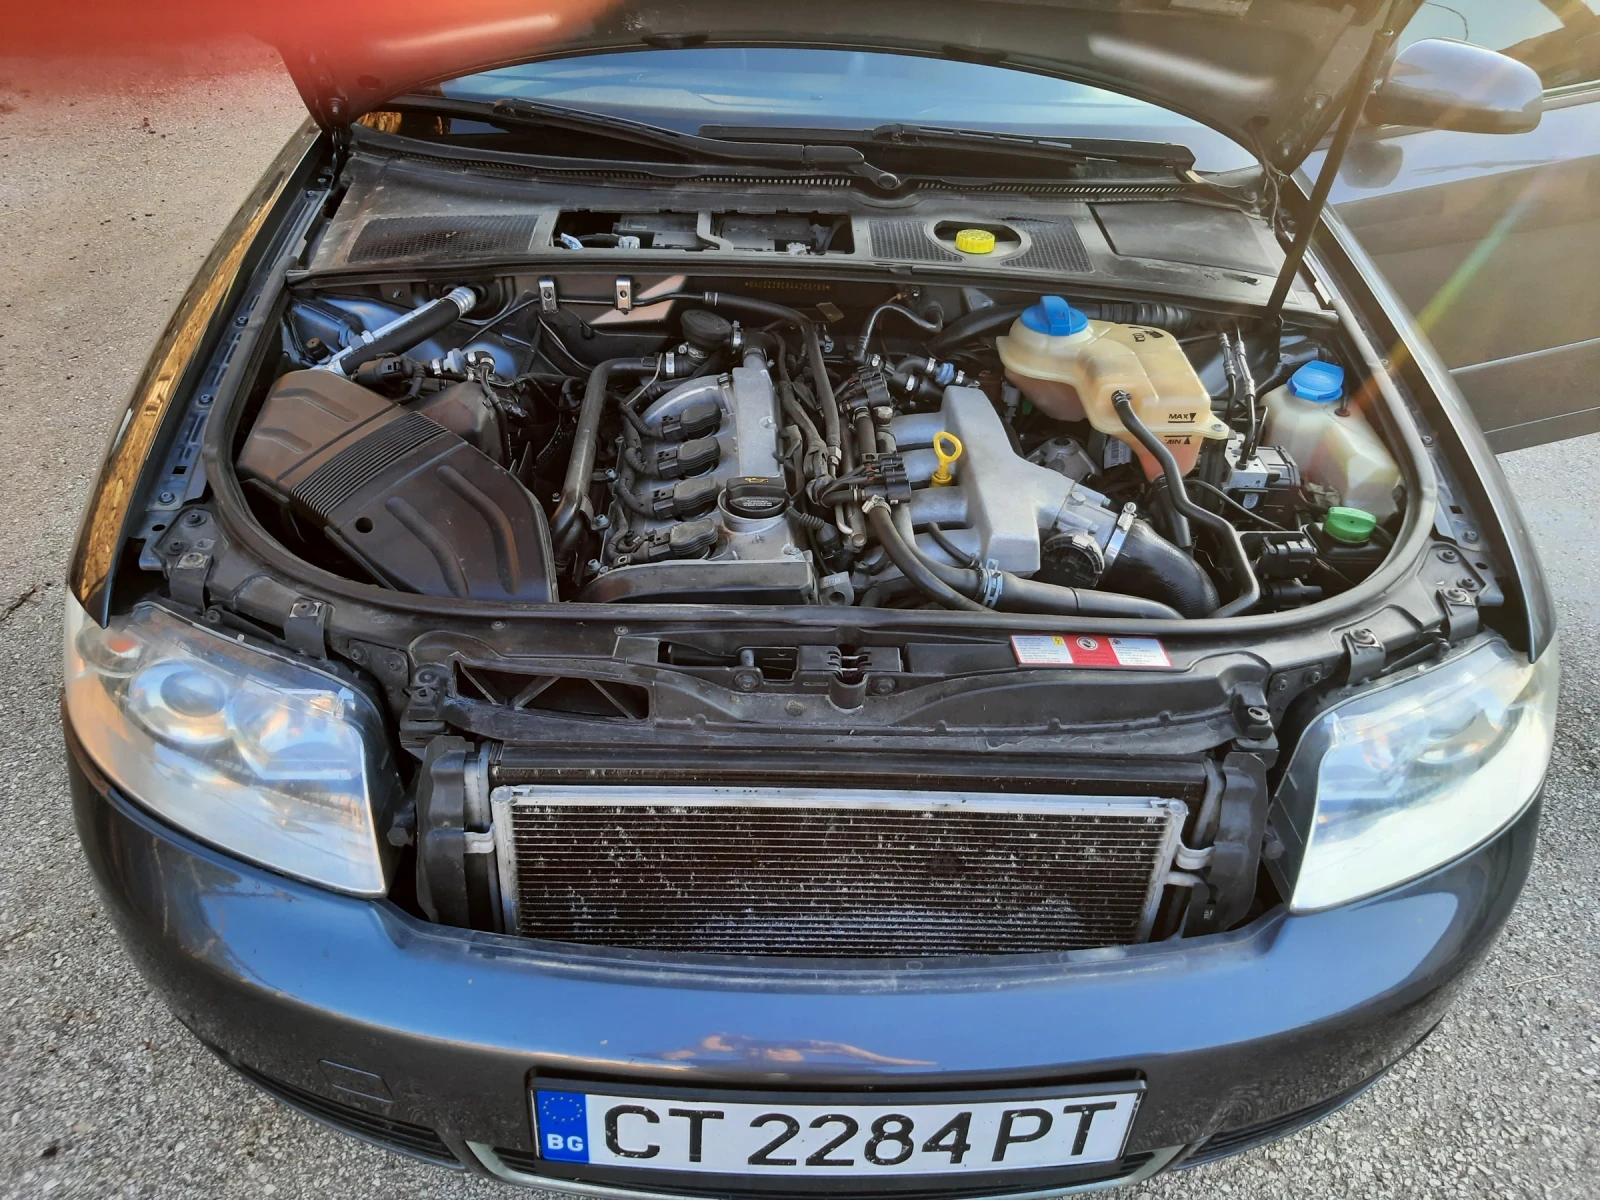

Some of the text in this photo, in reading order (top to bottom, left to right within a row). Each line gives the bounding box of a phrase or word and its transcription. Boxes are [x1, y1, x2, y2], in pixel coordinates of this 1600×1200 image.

[546, 1133, 584, 1152] BG
[604, 1101, 1117, 1167] CT 2284 PT
